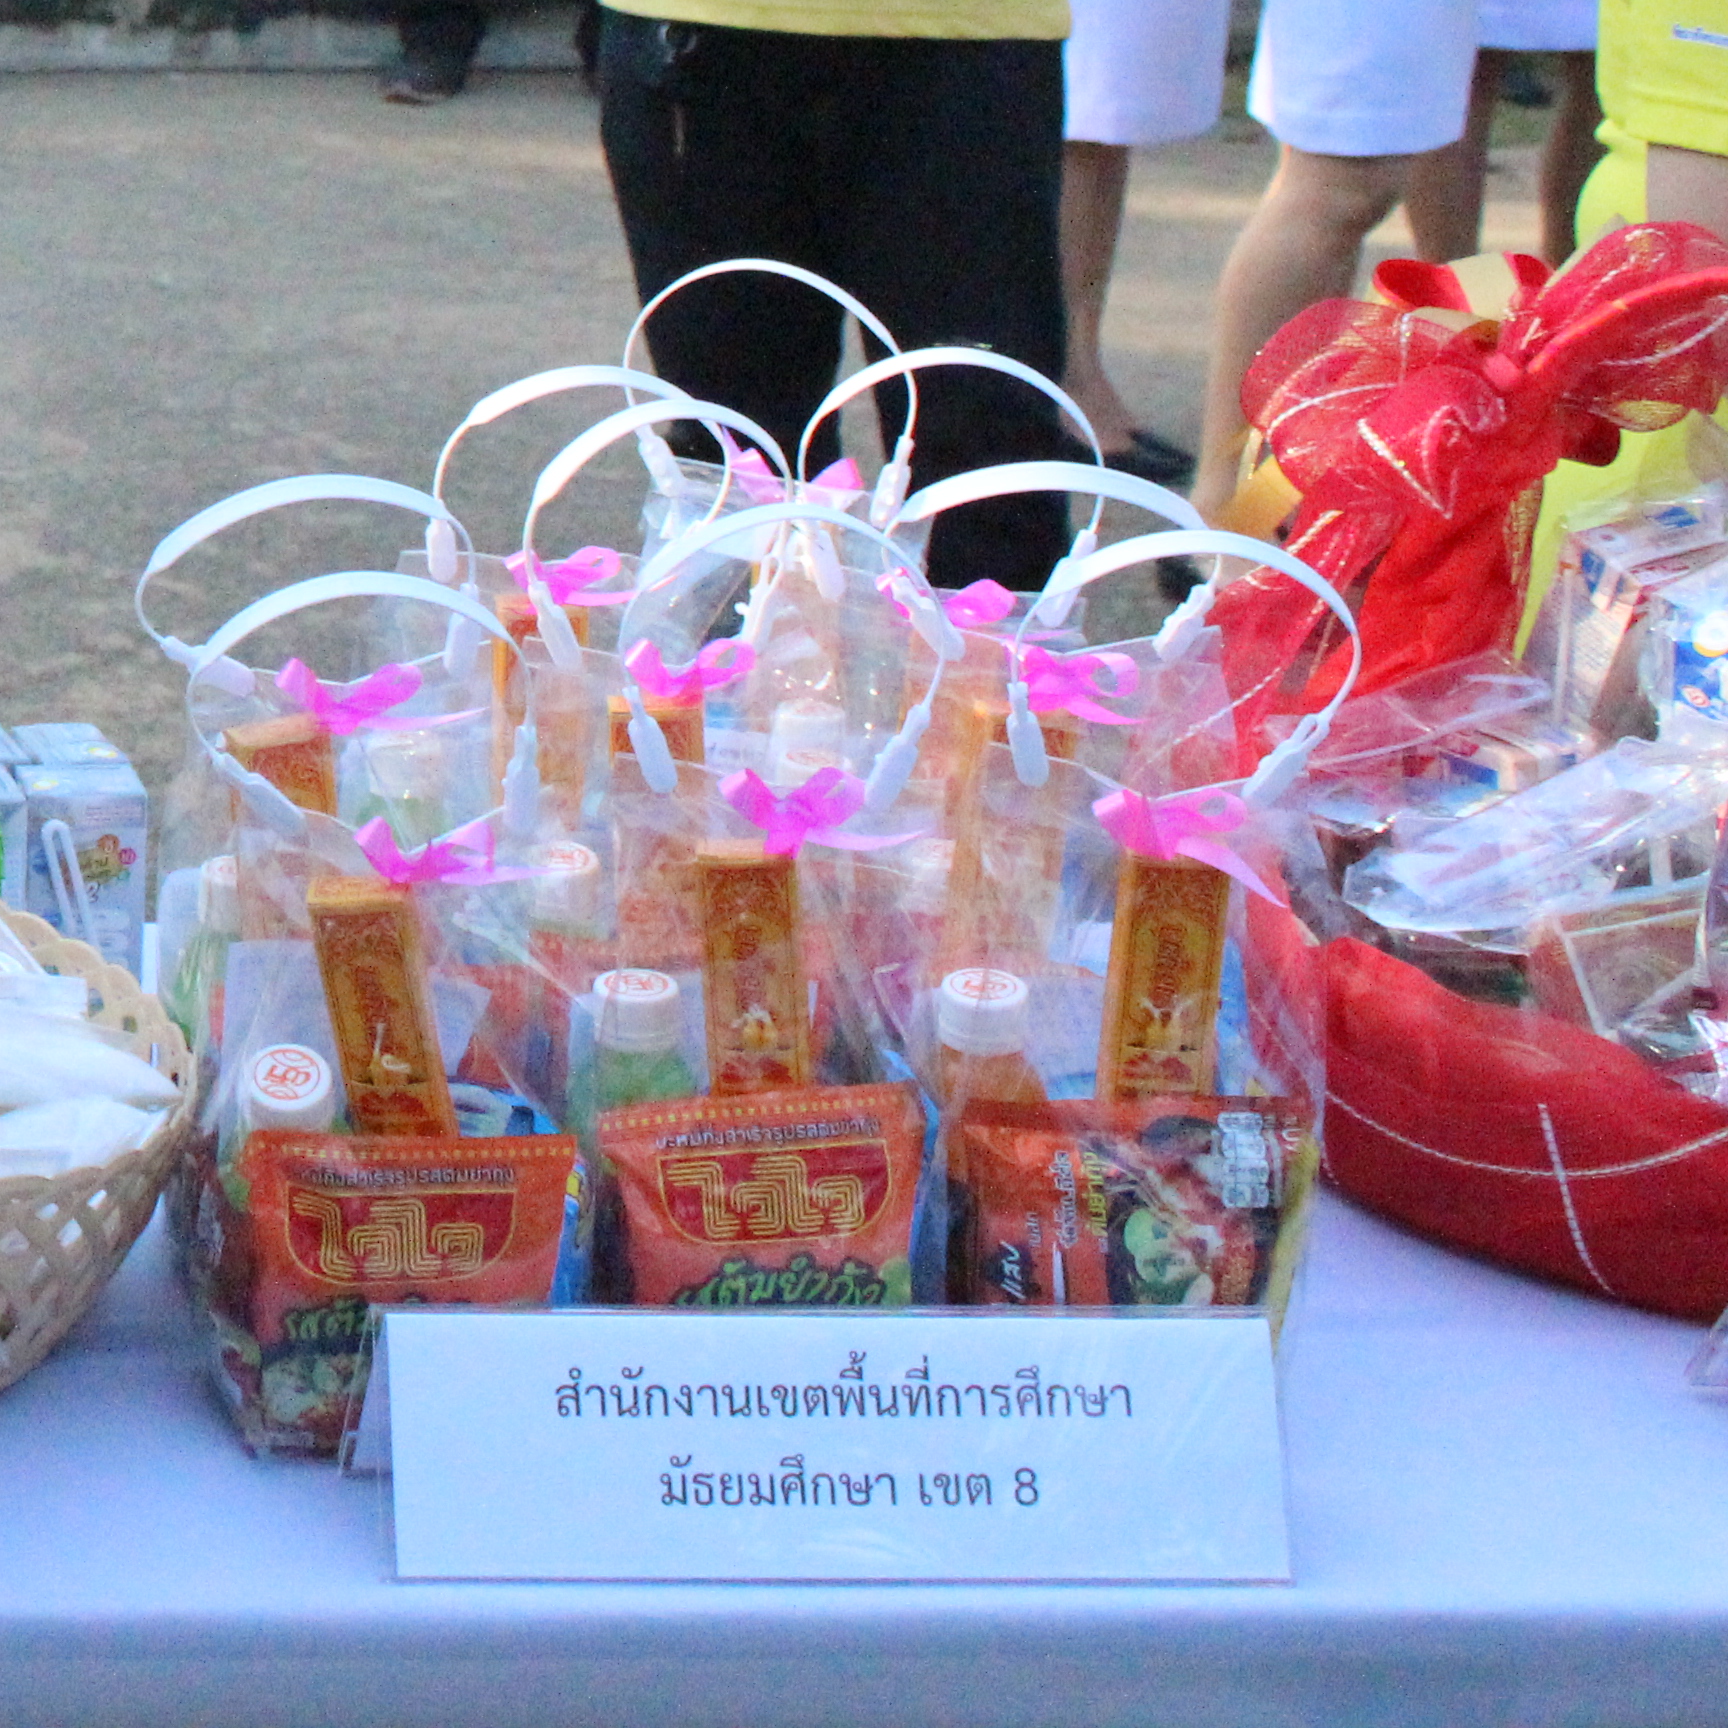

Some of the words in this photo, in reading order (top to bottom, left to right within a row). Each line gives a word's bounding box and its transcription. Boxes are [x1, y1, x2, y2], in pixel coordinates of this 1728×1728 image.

[666, 1152, 866, 1238] ไวไว
[292, 1190, 487, 1279] ไวไว
[554, 1351, 1135, 1420] สำนักงานเขตพื้นที่การศึกษา
[660, 1454, 897, 1510] มัธยมศึกษา
[918, 1468, 993, 1508] เขต
[1014, 1467, 1041, 1507] 8
